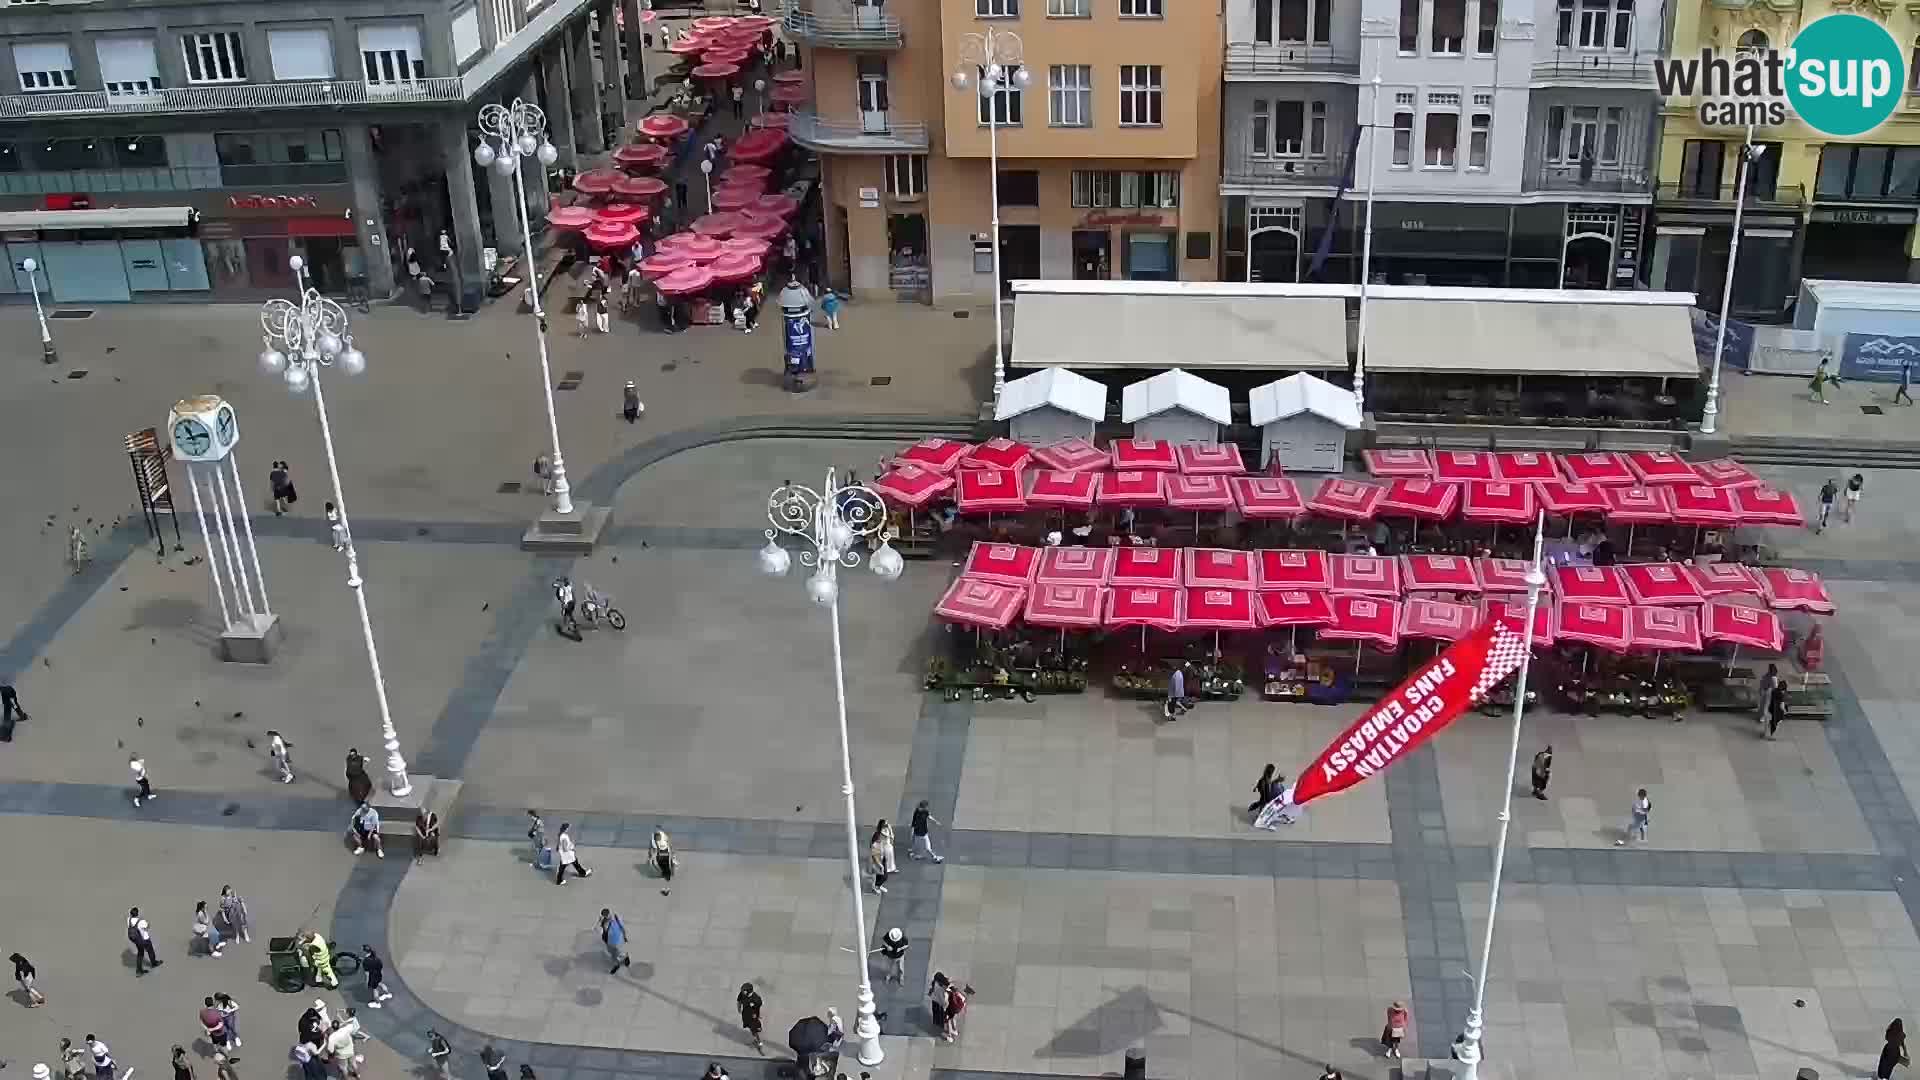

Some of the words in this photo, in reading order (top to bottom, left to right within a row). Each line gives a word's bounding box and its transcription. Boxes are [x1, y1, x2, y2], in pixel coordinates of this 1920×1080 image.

[1405, 658, 1456, 704] FANS
[1321, 700, 1405, 783] EMBASSY
[1355, 696, 1445, 778] CROATIAN
